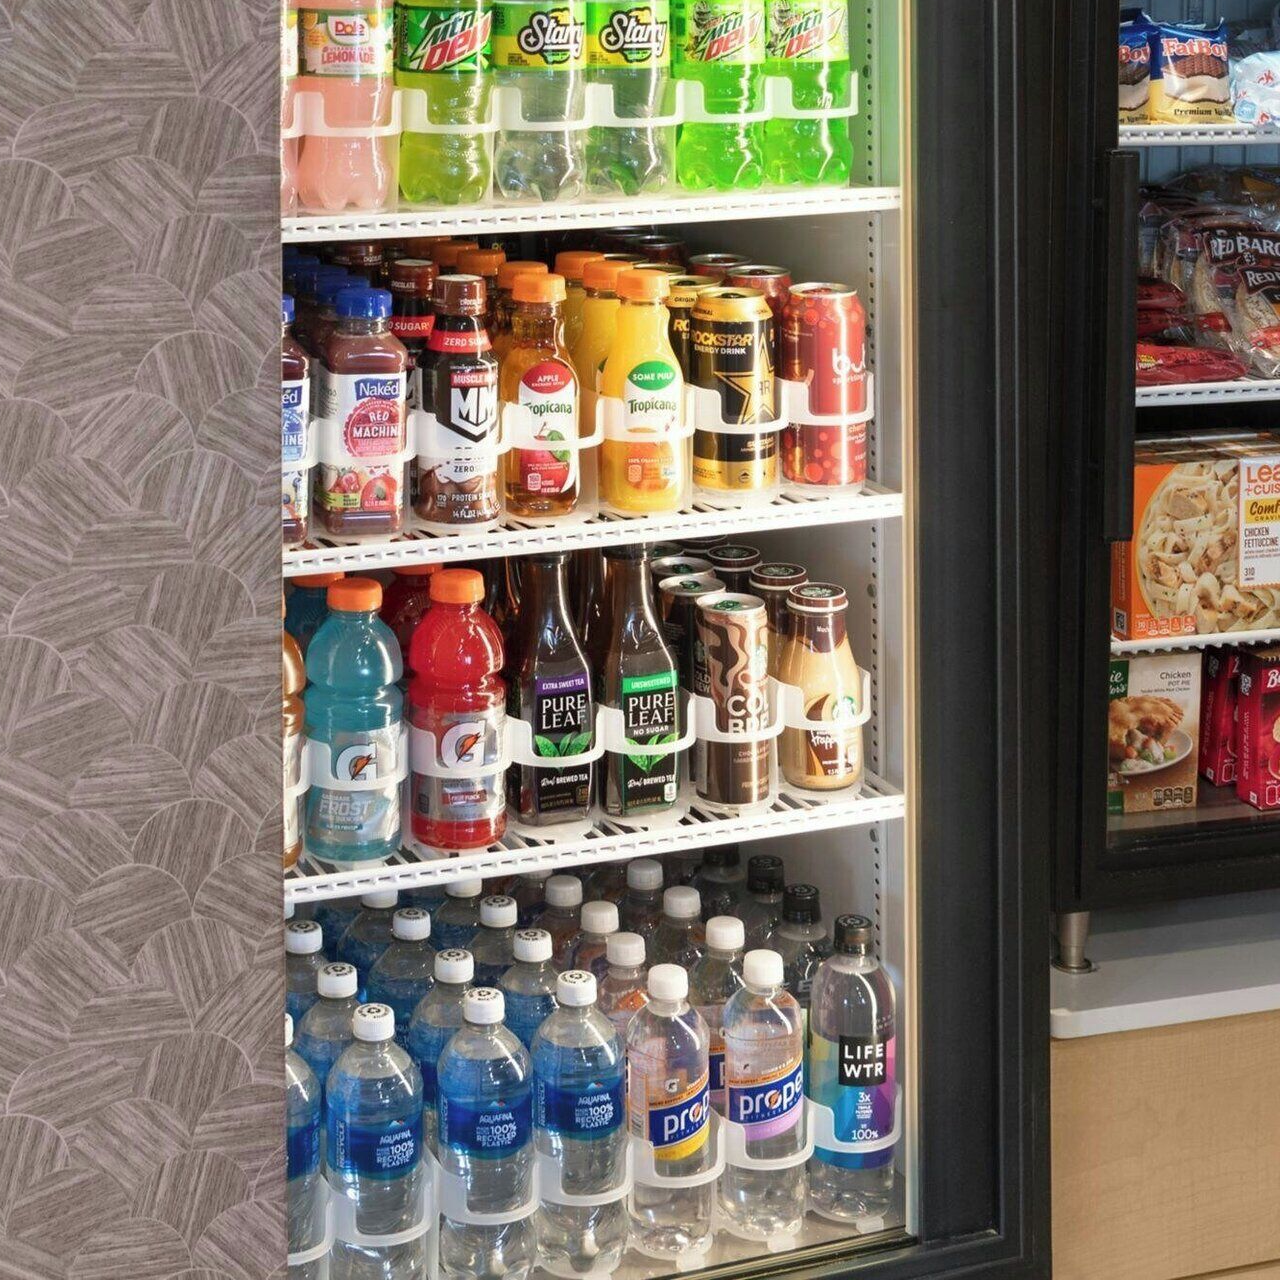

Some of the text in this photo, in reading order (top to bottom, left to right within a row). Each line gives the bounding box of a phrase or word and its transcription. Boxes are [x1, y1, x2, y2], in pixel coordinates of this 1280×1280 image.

[335, 20, 366, 34] Dole
[1119, 45, 1150, 63] Boy
[1161, 38, 1228, 62] FatBoy
[1209, 238, 1235, 259] RED
[443, 337, 467, 347] ZERO
[720, 347, 746, 355] DRINK
[632, 372, 657, 381] SOME
[359, 380, 400, 396] Naked
[627, 395, 677, 415] Tropicana
[369, 411, 390, 423] RED
[353, 425, 400, 438] MACHIN
[1244, 526, 1270, 538] CHICKEN
[1159, 670, 1192, 680] Chicken
[542, 681, 558, 690] EXTRA
[558, 680, 575, 688] SWEET
[542, 693, 586, 714] PURE
[628, 692, 674, 715] PURE
[542, 709, 586, 730] LEAF
[628, 708, 674, 728] LEAF
[633, 725, 669, 736] NO SUGAR
[441, 720, 487, 769] G
[844, 1043, 884, 1060] LIFE
[843, 1062, 884, 1078] WTR
[578, 1092, 612, 1106] AQUAFINA
[739, 1070, 803, 1121] prope
[589, 1102, 614, 1116] 100%
[663, 1089, 710, 1142] prop
[479, 1111, 515, 1124] AQUAFINA
[490, 1122, 517, 1135] 100%
[379, 1129, 412, 1146] AQUAFINA
[390, 1139, 414, 1156] 100%
